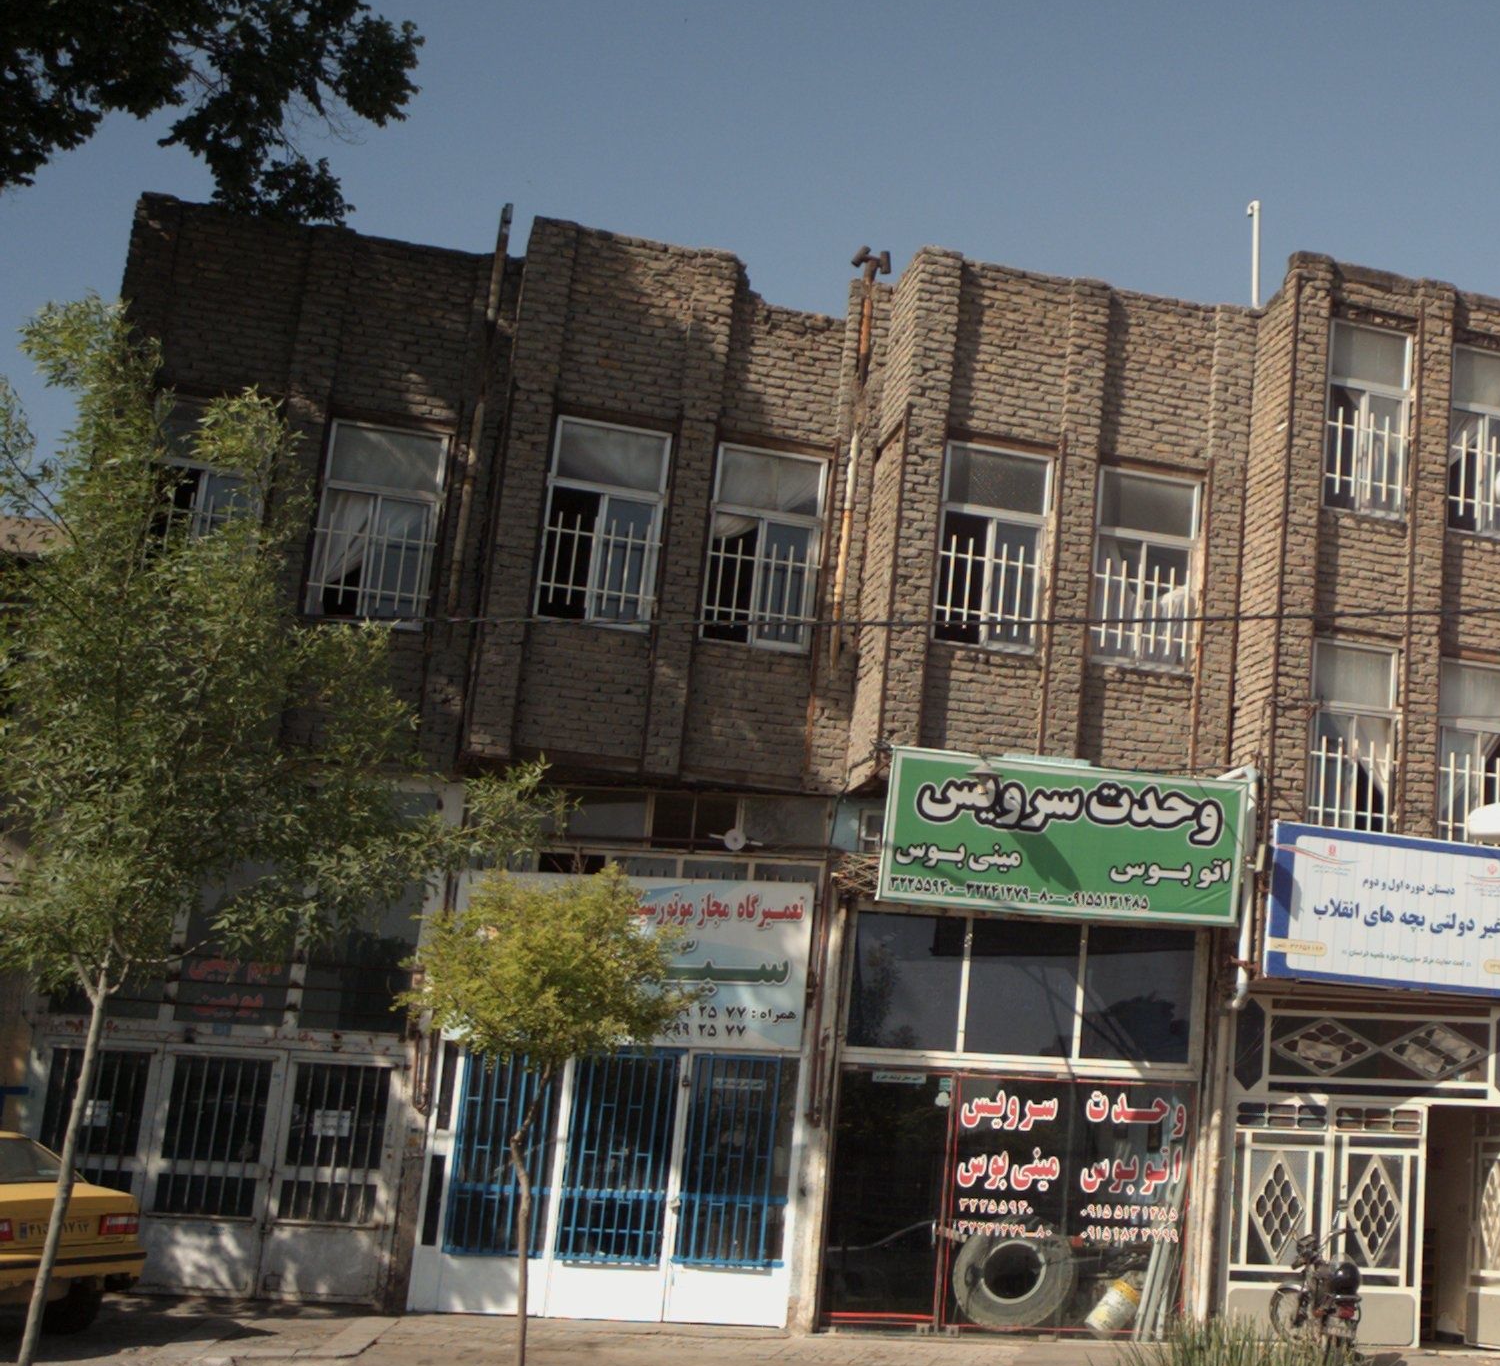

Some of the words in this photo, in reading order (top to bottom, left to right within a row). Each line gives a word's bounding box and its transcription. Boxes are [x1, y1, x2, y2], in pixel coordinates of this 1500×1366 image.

[916, 778, 1084, 834] سرویس
[1086, 781, 1223, 846] وحدت
[895, 842, 966, 869] بوس
[1363, 877, 1380, 889] دوم
[1388, 880, 1404, 892] اول
[1405, 882, 1425, 894] دوره
[1427, 883, 1455, 896] دبستان
[697, 892, 730, 928] مجاز
[737, 893, 806, 928] تعمیرگاه
[1313, 898, 1359, 921] انقلاب
[1364, 904, 1394, 927] های
[1400, 914, 1425, 934] بچه
[1430, 913, 1475, 937] دولتی
[725, 1006, 746, 1018] ۷۷
[725, 1025, 746, 1037] ۷۷
[961, 1090, 1058, 1130] سرویس
[1086, 1091, 1187, 1136] وحدت
